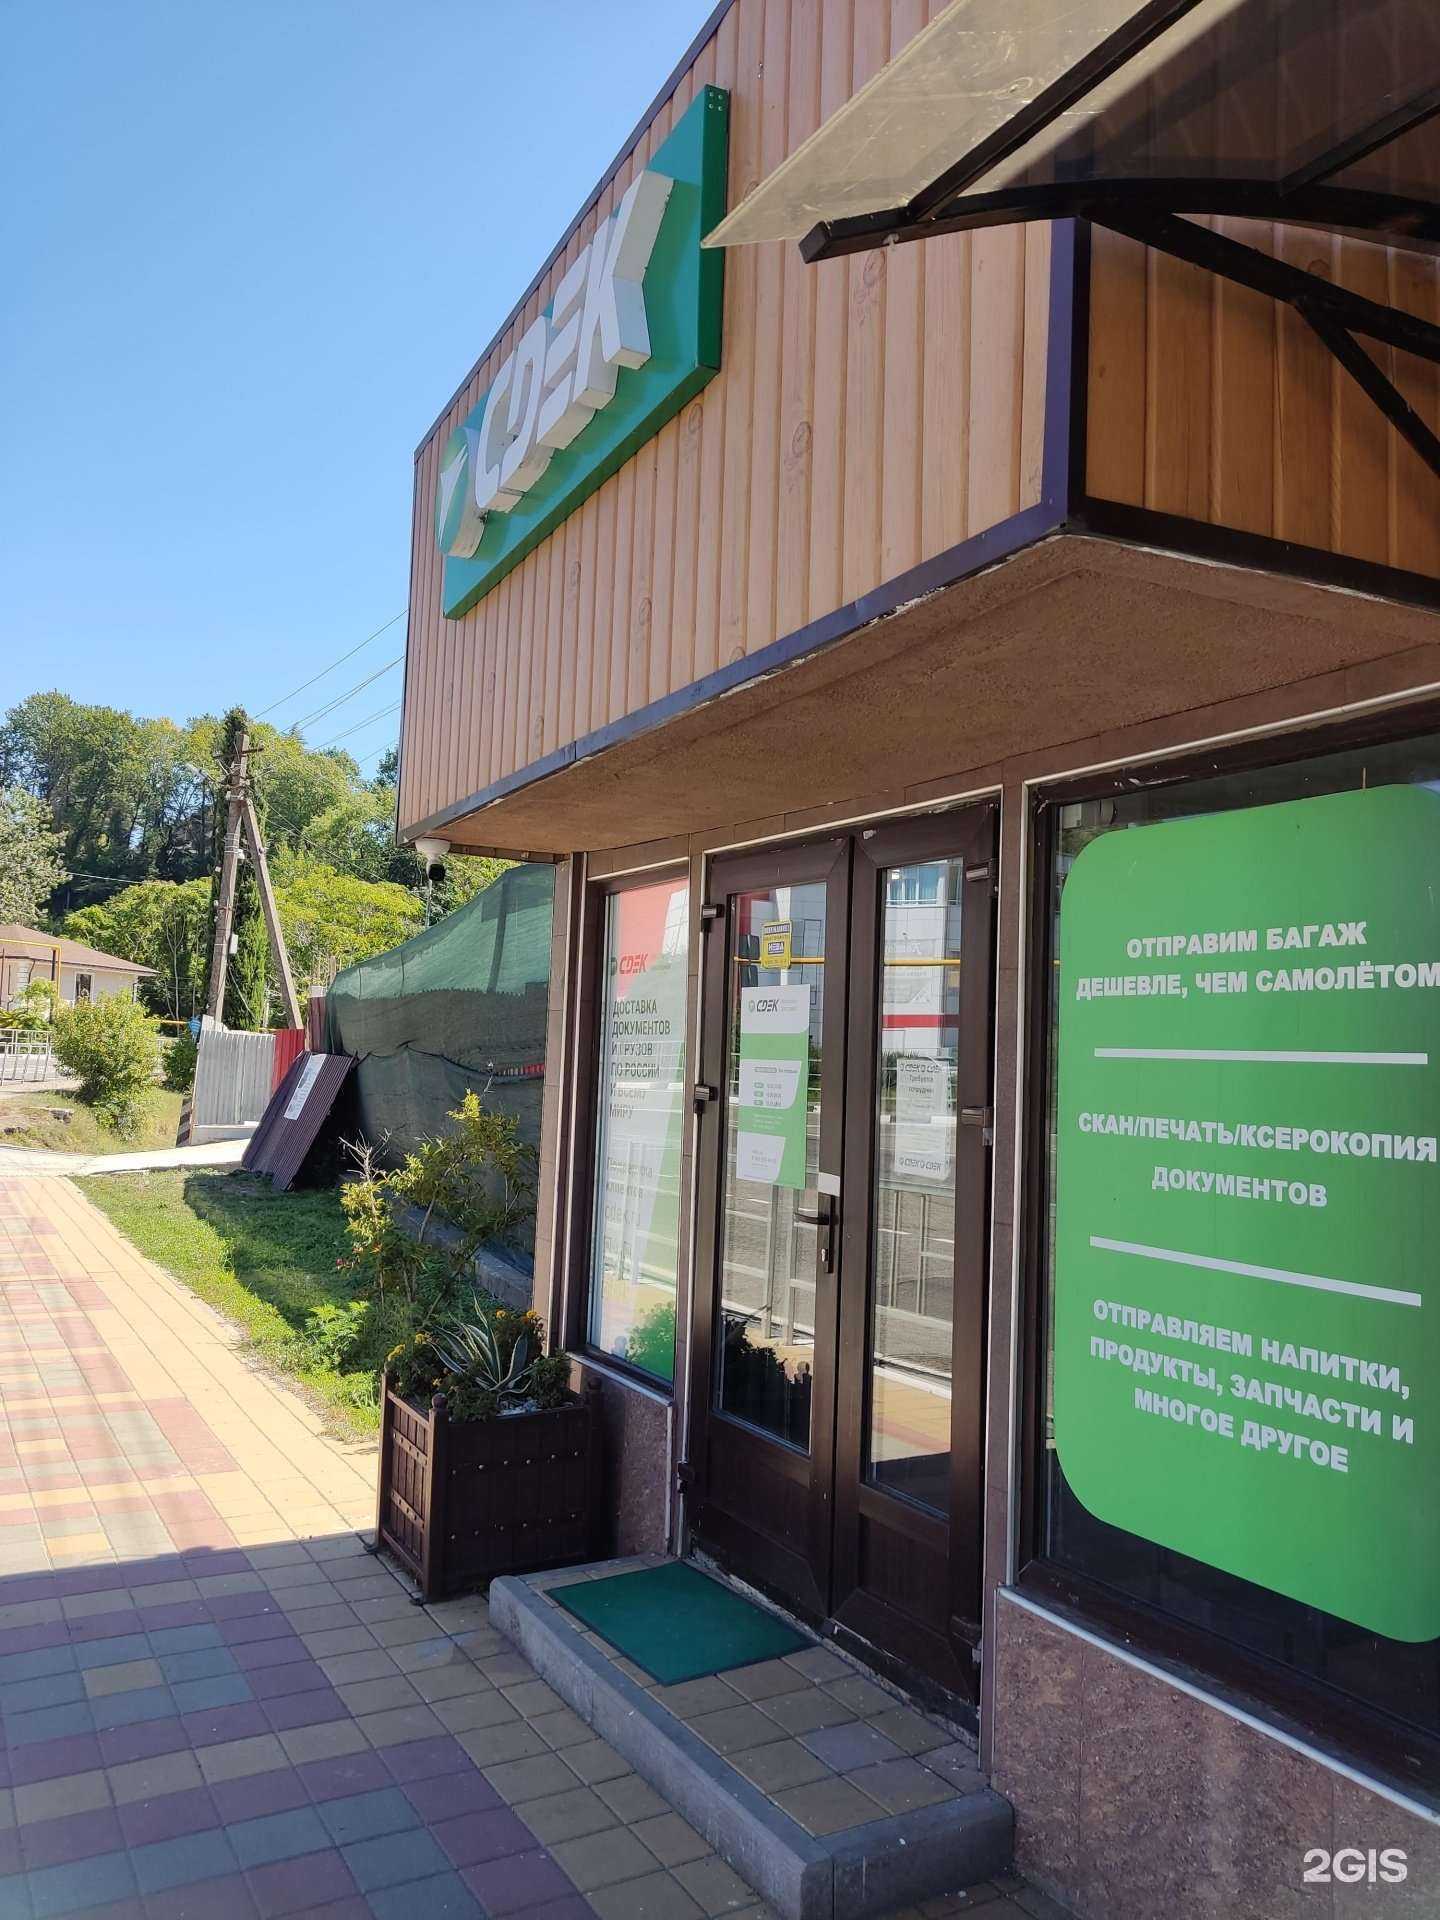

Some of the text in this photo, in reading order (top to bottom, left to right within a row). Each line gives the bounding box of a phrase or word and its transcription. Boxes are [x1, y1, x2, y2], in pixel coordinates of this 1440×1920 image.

[1126, 921, 1368, 959] ОТПРАВИМ БАГАЖ
[1075, 961, 1440, 1000] ДЕШЕВЛЕ, ЧЕМ САМОЛЁТОМ
[611, 1020, 671, 1038] ДОКУМЕНТОВ
[612, 998, 658, 1019] ДОСТАВКА
[1078, 1112, 1438, 1163] СКАН/ПЕЧАТЬ/КСЕРОКОПИЯ
[1151, 1166, 1328, 1207] ДОКУМЕНТОВ
[1093, 1299, 1410, 1400] ОТПРАВЛЯЕМ НАПИТКИ,
[1090, 1335, 1414, 1444] ПРОДУКТЫ, ЗАПЧАСТИ И
[1134, 1387, 1349, 1473] МНОГОЕ ДРУГОЕ
